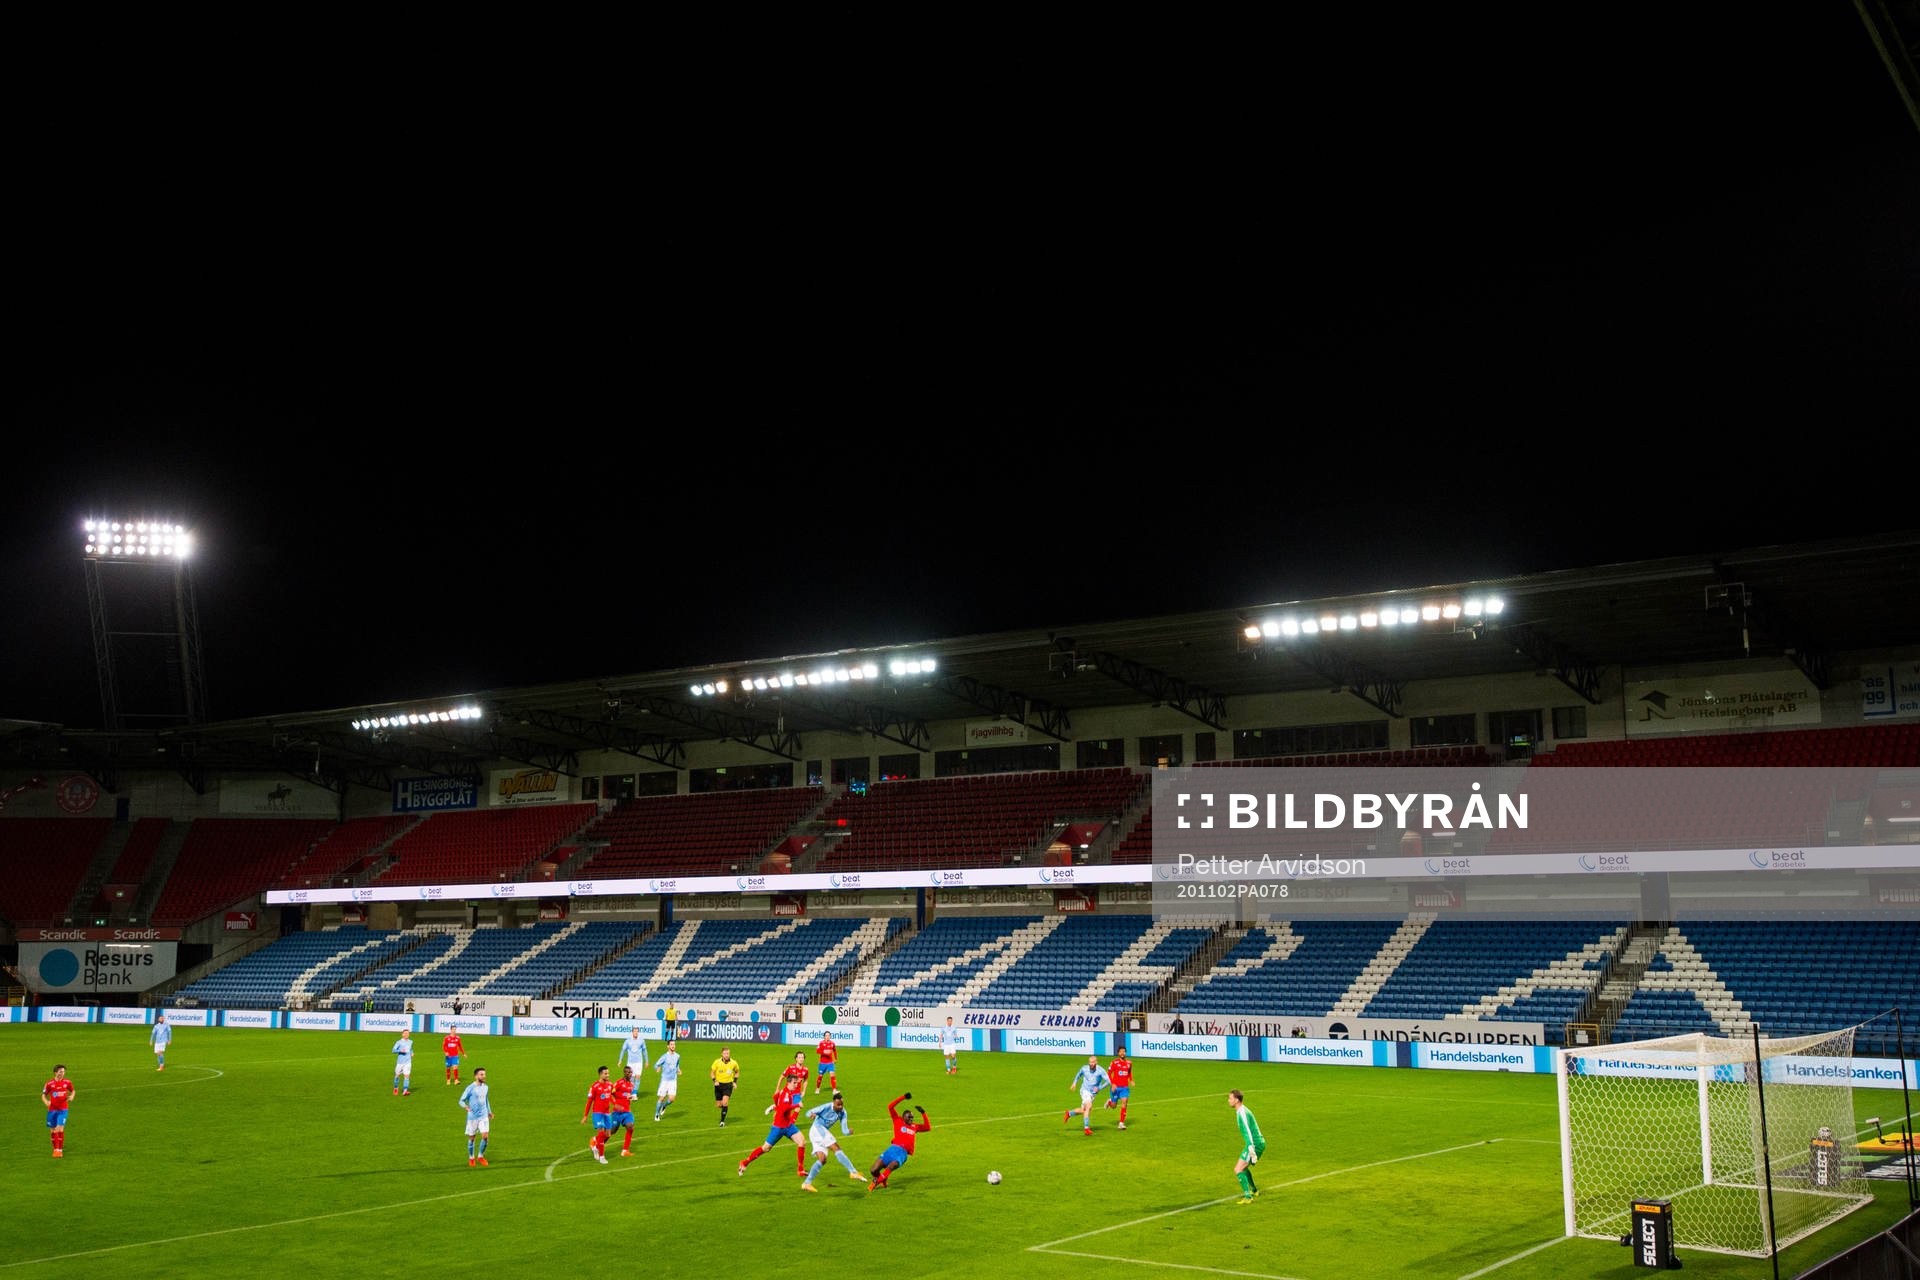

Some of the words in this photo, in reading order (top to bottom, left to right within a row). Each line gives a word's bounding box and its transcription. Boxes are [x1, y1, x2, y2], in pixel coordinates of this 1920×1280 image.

[1778, 703, 1797, 713] AB
[413, 788, 473, 808] BYGGPLÅT
[1599, 854, 1629, 865] beat
[1772, 850, 1805, 861] beat
[1443, 858, 1470, 868] beat
[1772, 860, 1806, 868] diabetes
[944, 871, 963, 880] beat
[1053, 868, 1074, 878] beat
[748, 877, 765, 885] beat
[842, 875, 860, 883] beat
[1059, 899, 1086, 911] PUMA
[1415, 894, 1450, 907] PUMA
[775, 904, 798, 915] PUMA
[226, 920, 249, 930] PUMA
[40, 929, 87, 940] Scandic
[114, 929, 161, 940] Scandic
[85, 950, 153, 966] Resurs
[84, 969, 132, 985] Bank
[838, 1006, 860, 1018] Solid
[901, 1008, 924, 1019] Solid
[365, 1019, 408, 1027] Handelsbanken
[964, 1013, 1021, 1026] EKBLADHS
[1040, 1014, 1101, 1028] EKBLADHS
[519, 1022, 568, 1033] Handelsbanken
[695, 1023, 754, 1041] HELSINGBORG
[1015, 1035, 1087, 1049] Handelsbanken
[1141, 1040, 1218, 1053] Handelsbanken
[1279, 1045, 1364, 1059] Handelsbanken
[1430, 1050, 1524, 1065] Handelsbanken
[1786, 1063, 1903, 1080] Handelsbanken
[1641, 1218, 1657, 1266] SELECT
